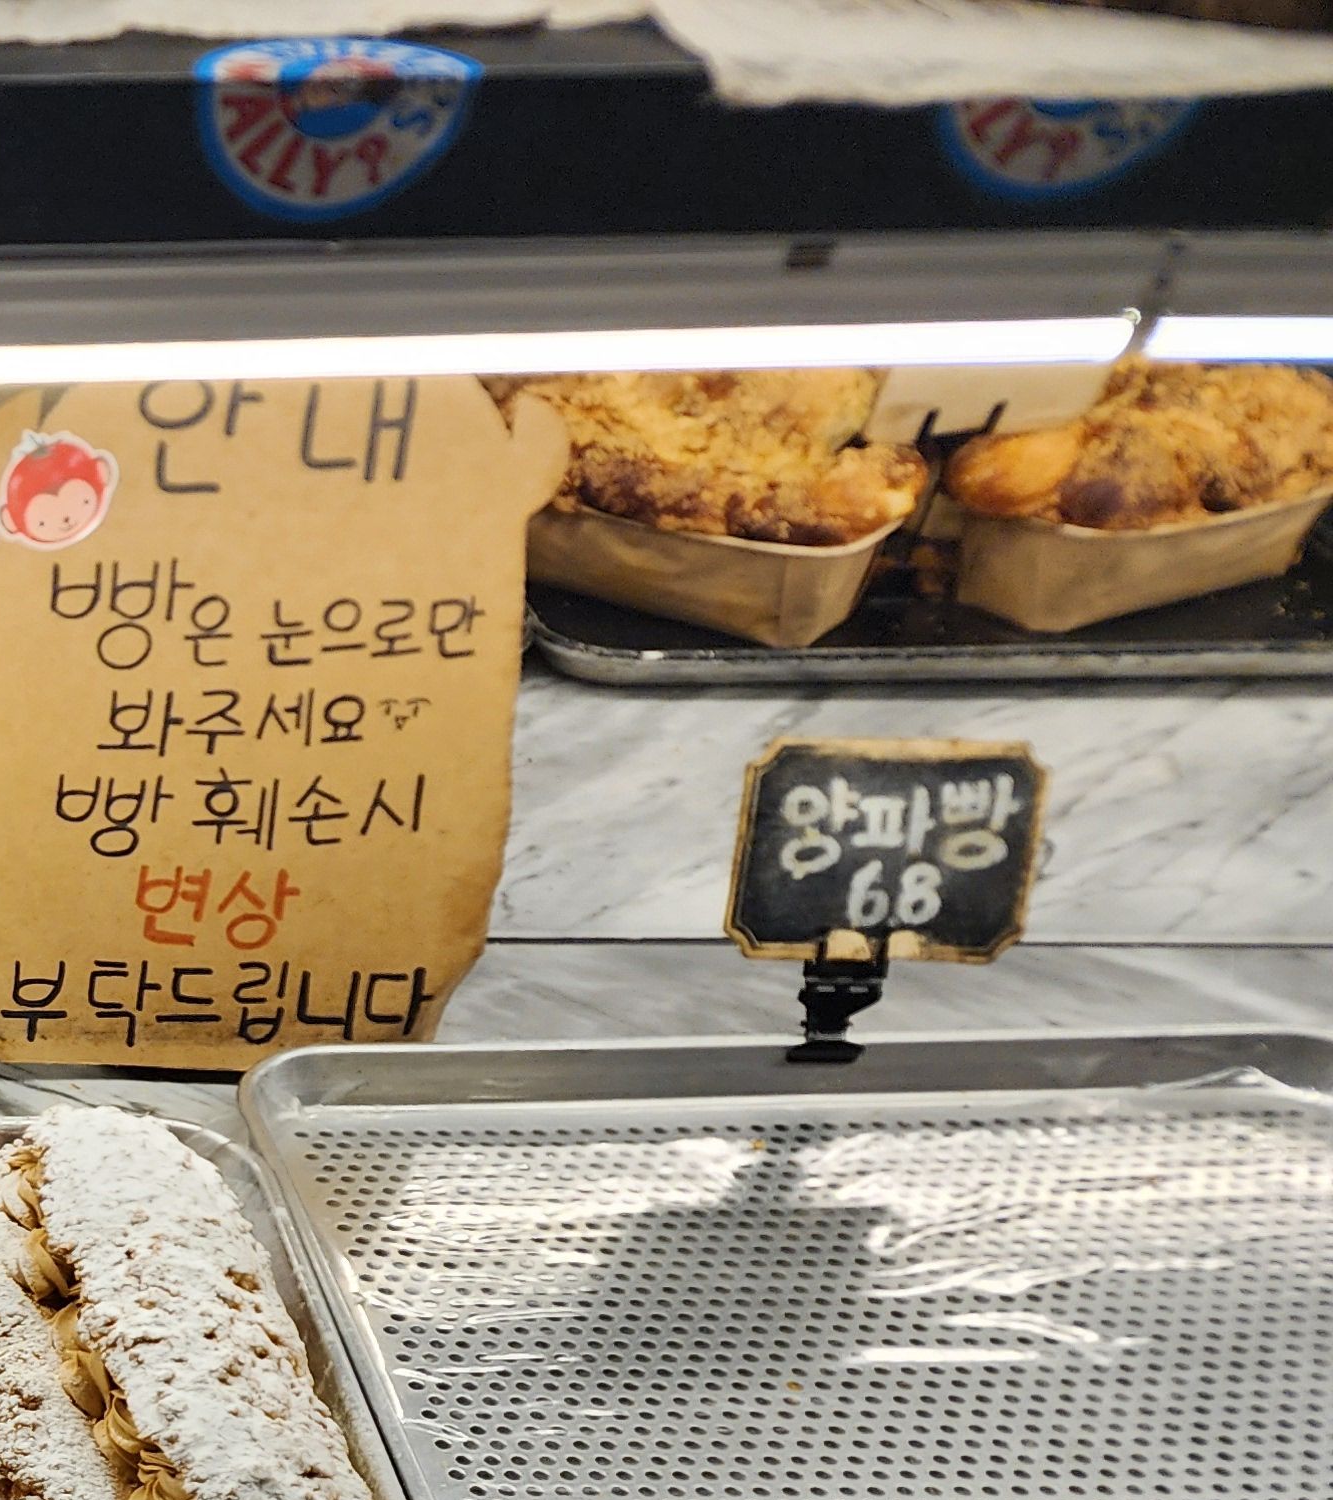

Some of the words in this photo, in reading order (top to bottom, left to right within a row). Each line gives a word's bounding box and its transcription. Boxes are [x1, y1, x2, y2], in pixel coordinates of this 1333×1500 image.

[138, 379, 418, 494] 안내
[50, 557, 233, 670] 빵은
[259, 595, 486, 667] 눈으로만
[96, 687, 367, 757] 봐주세요
[55, 773, 175, 858] 빵
[779, 773, 1024, 880] 양파빵
[134, 863, 301, 951] 변상
[0, 958, 434, 1048] 부탁드립니다
